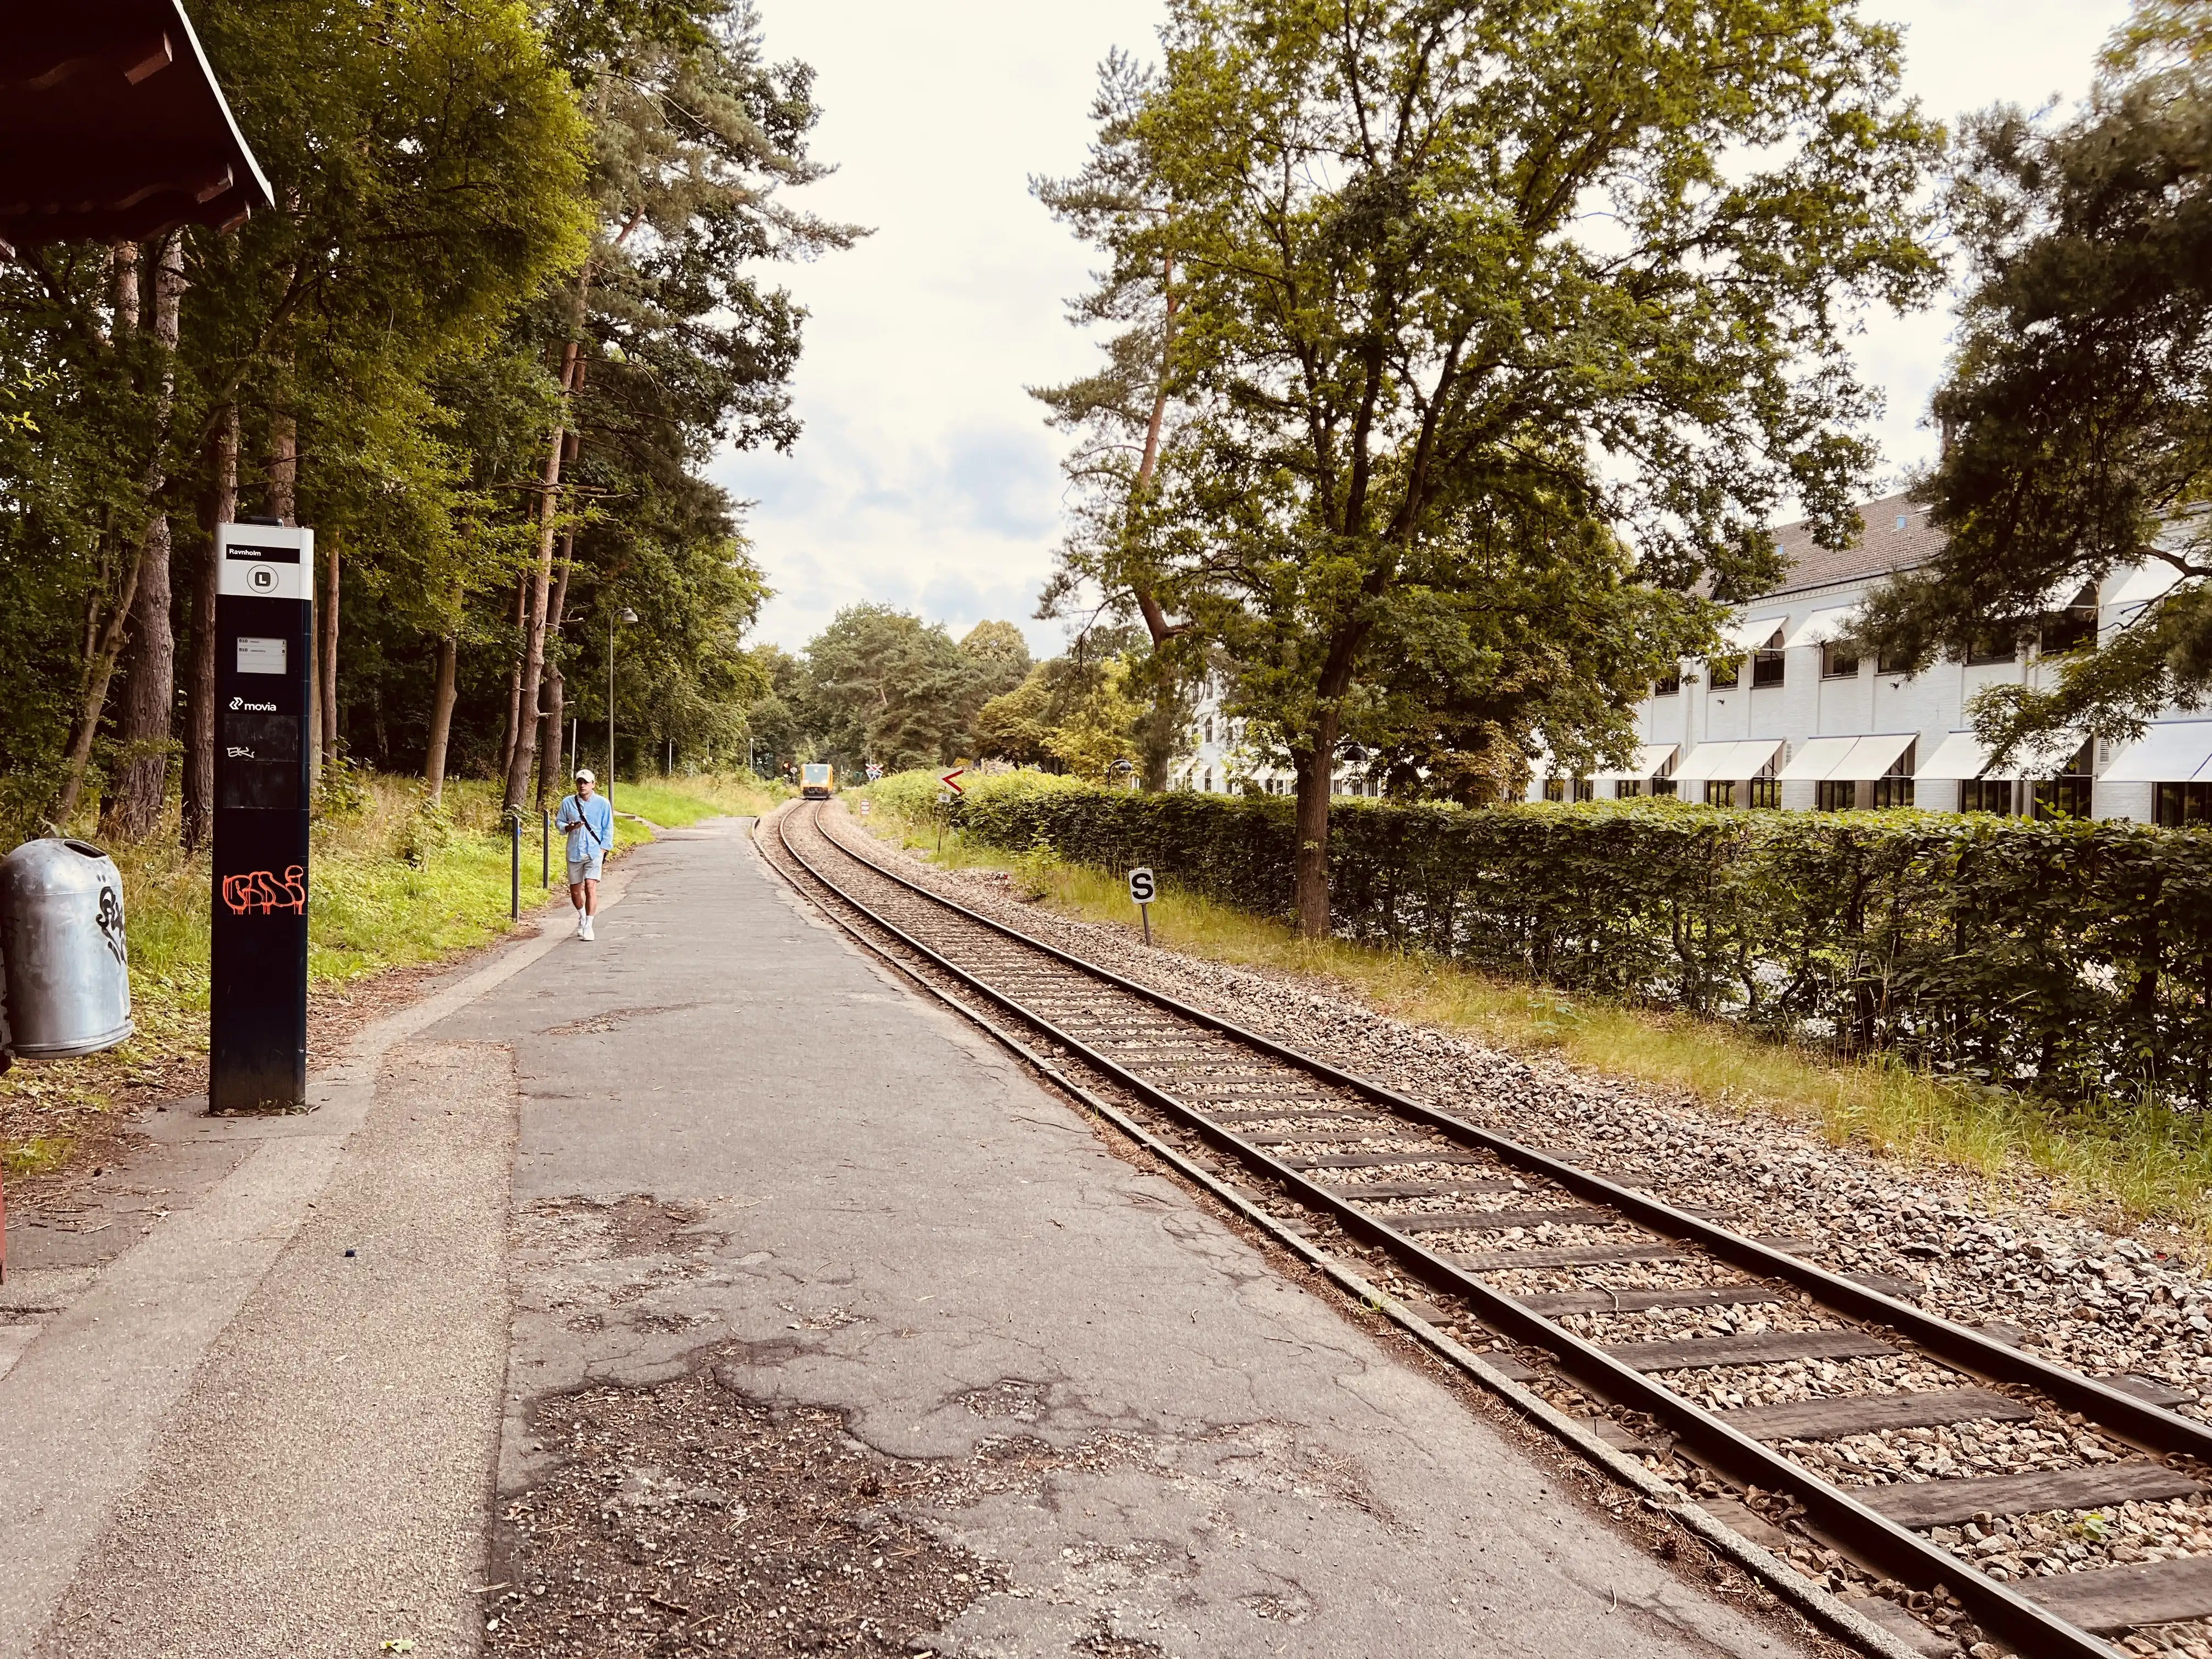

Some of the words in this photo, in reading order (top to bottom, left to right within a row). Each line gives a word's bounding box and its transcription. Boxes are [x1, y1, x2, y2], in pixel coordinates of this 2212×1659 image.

[229, 548, 261, 556] Ravnholm
[258, 574, 267, 584] L
[244, 702, 276, 711] movia
[1131, 873, 1154, 900] S
